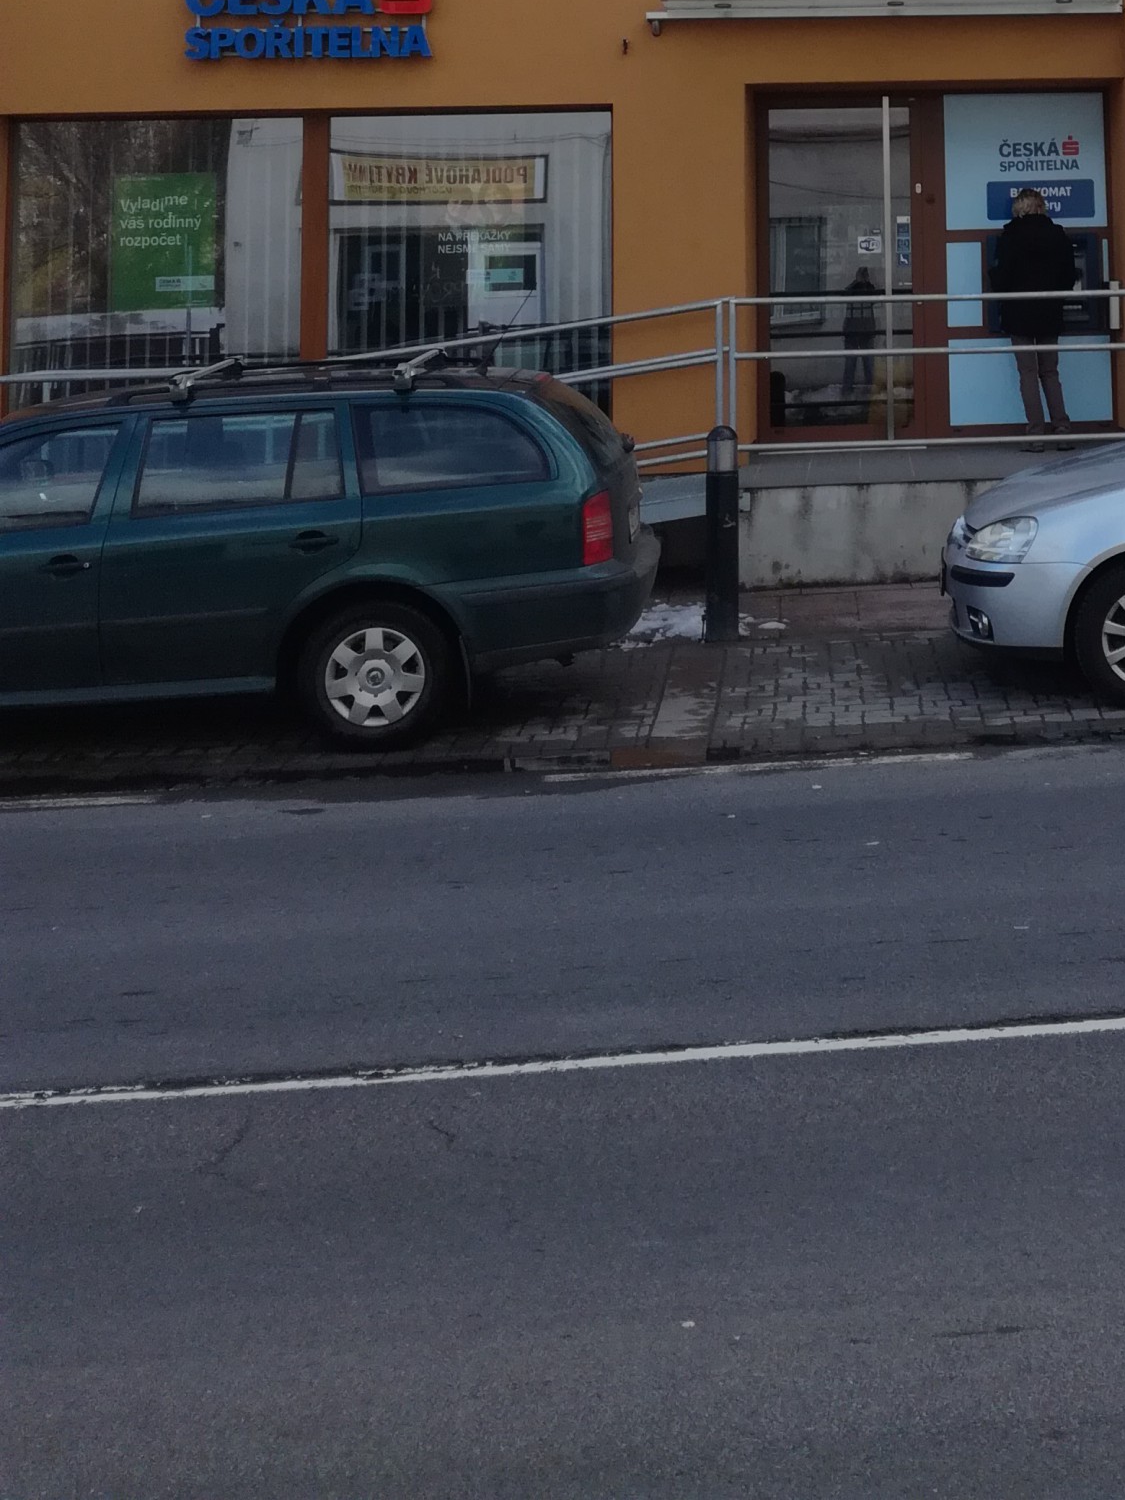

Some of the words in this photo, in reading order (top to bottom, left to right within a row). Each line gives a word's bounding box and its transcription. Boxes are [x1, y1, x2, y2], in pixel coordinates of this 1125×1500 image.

[184, 19, 432, 60] SPOŘITELNA
[999, 138, 1060, 158] ČESKÁ
[999, 158, 1080, 173] SPOŘITELNA
[1010, 186, 1072, 198] BOMAT
[120, 233, 182, 249] rozpočet
[438, 232, 453, 241] NA
